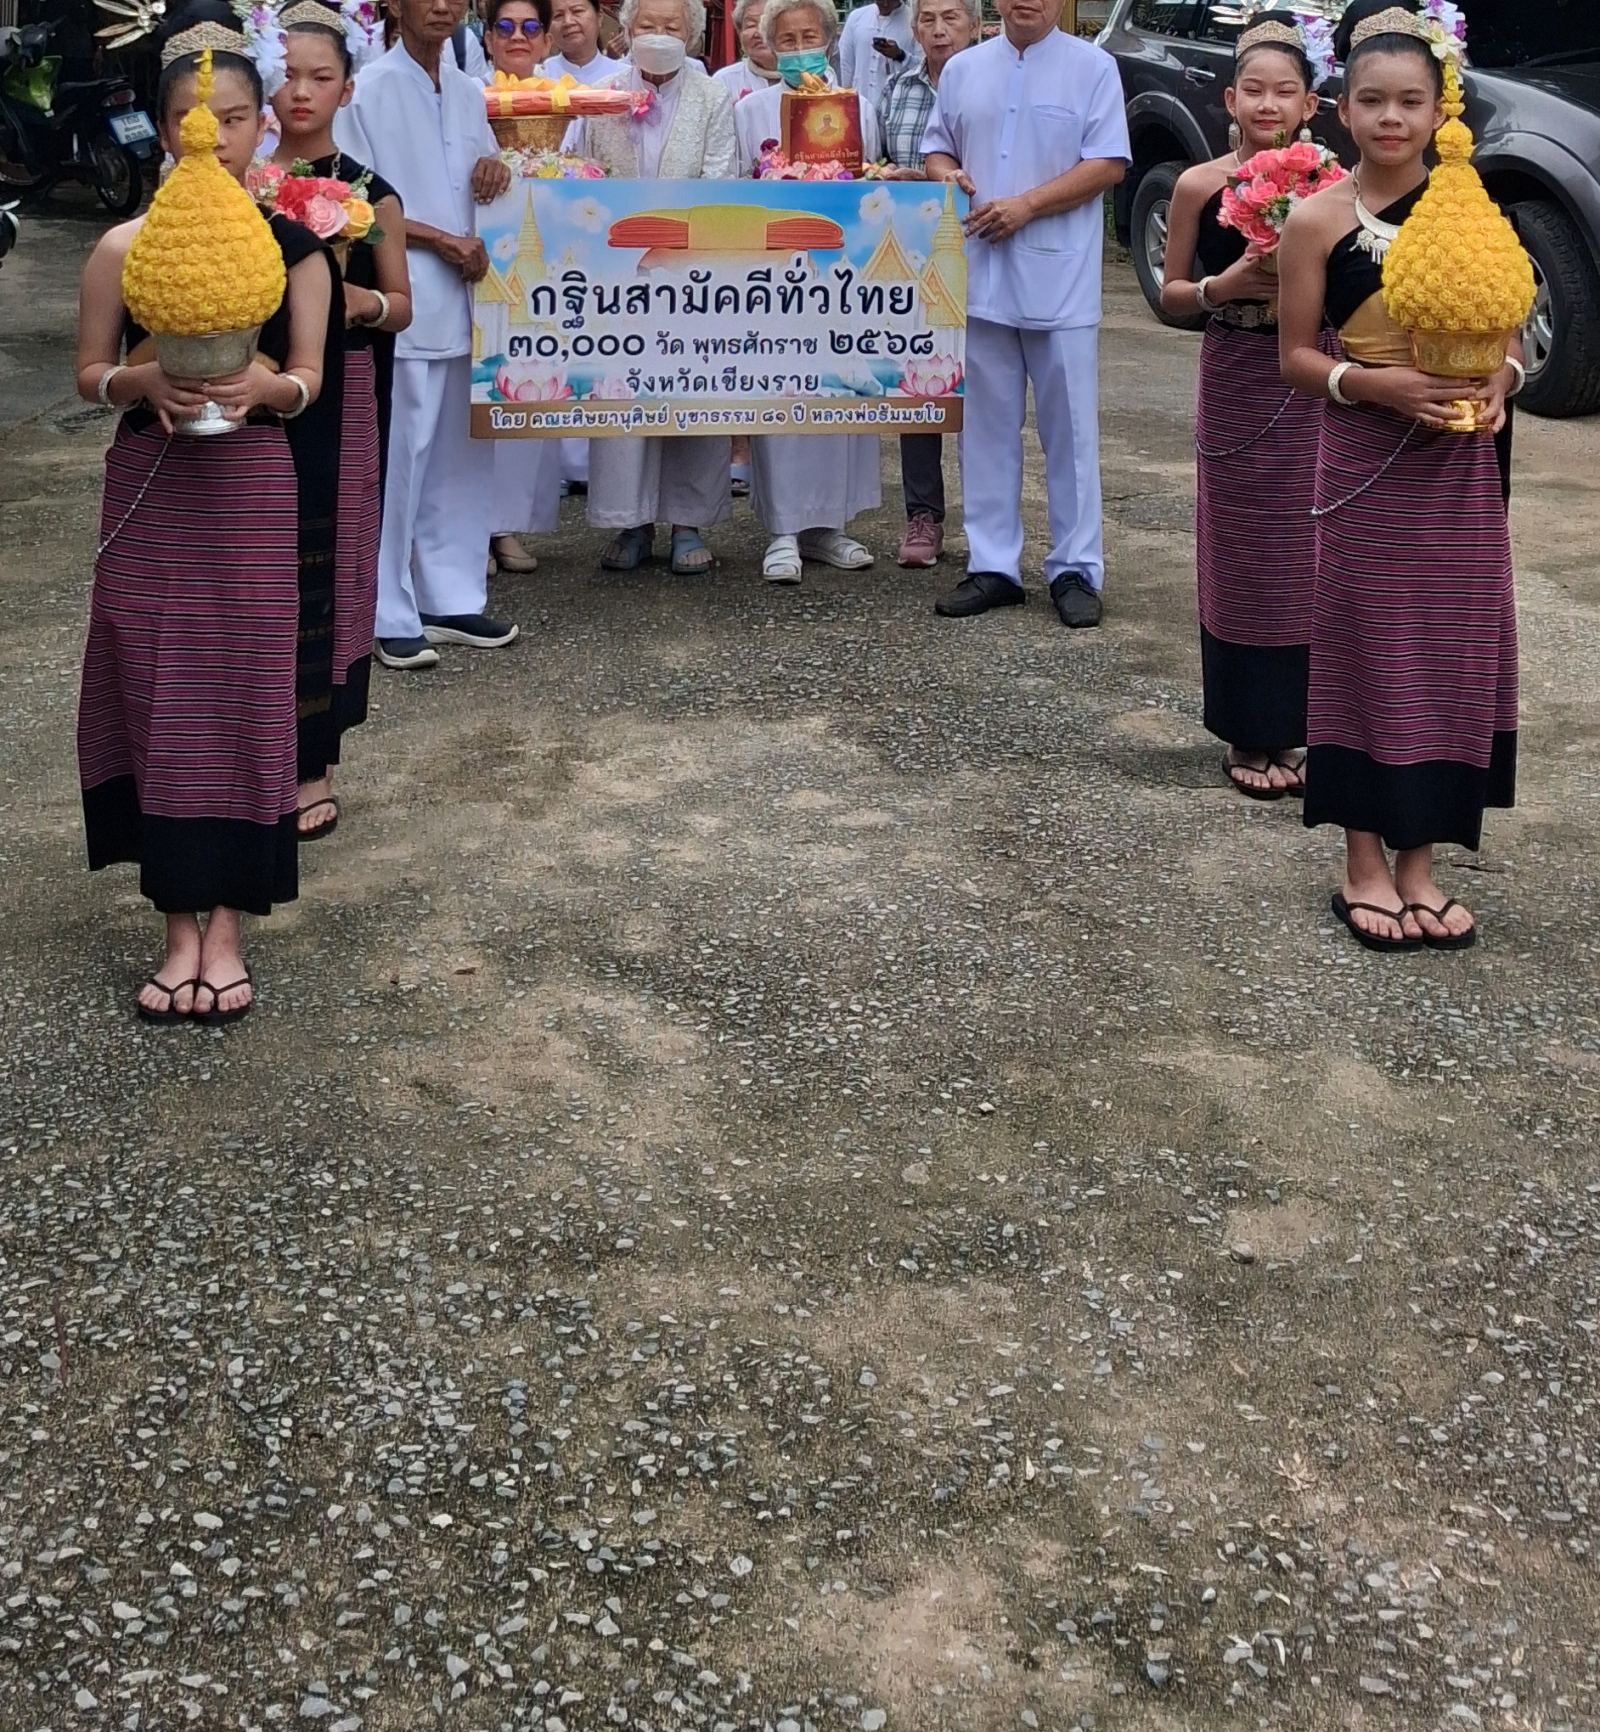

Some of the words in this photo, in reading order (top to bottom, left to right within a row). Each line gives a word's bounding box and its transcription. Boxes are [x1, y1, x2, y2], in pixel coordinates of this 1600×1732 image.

[531, 257, 914, 329] กฐินสามัคคีทั่วไทย
[508, 333, 645, 362] ๓๐,๐๐๐
[656, 330, 684, 356] วัด
[693, 330, 818, 364] พุทธศักราช
[829, 328, 934, 355] ๒๕๖๘
[626, 366, 819, 394] จังหวัดเชียงราย
[491, 408, 526, 428] โดย
[531, 404, 670, 431] คณะศิษยานุศิษย์
[675, 409, 756, 430] บูชาธรรม
[793, 404, 805, 422] ปี
